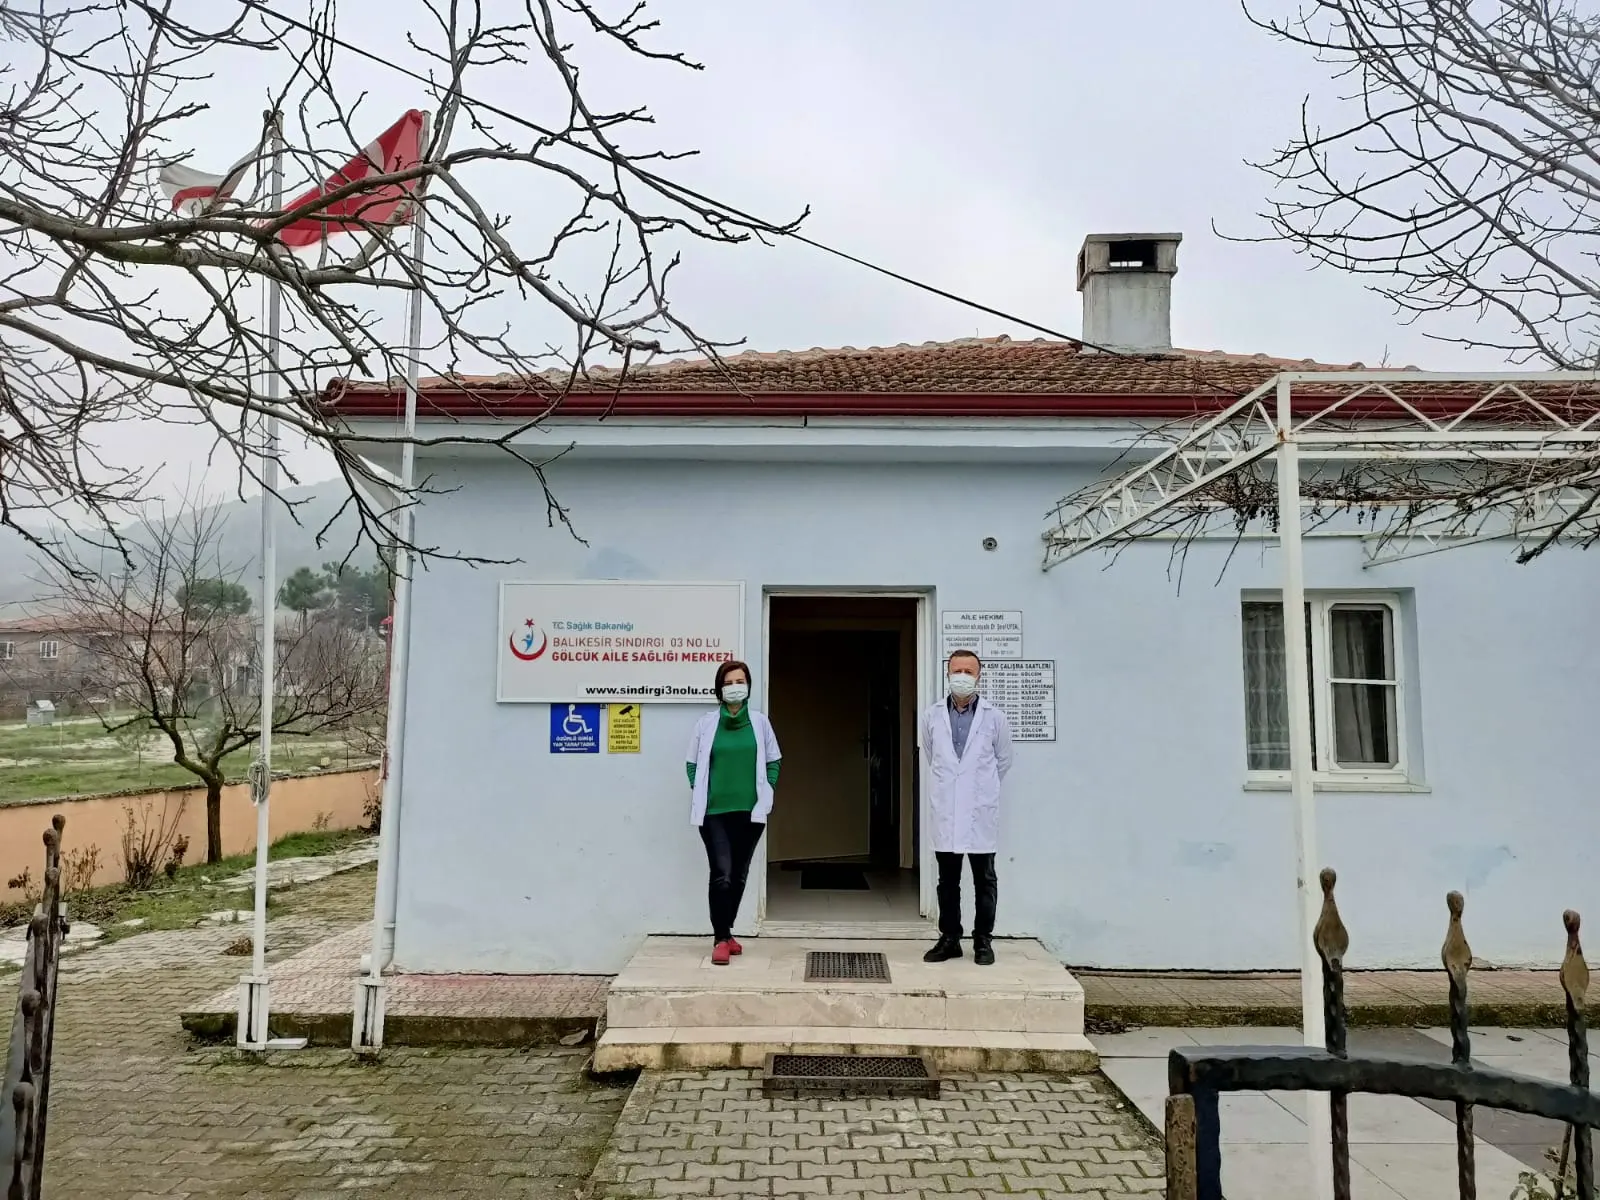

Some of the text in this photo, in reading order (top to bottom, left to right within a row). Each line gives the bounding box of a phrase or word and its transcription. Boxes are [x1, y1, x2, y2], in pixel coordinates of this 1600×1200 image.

[566, 621, 593, 631] Sağlık
[595, 621, 634, 632] Bakanlığı
[553, 636, 721, 648] BALIKESİR SINDIRGI 03 NO LU
[552, 649, 734, 662] GÖLCÜK AİLE SAĞLIĞI MERKEZİ
[585, 685, 718, 696] www.sindirgi3nolu.co
